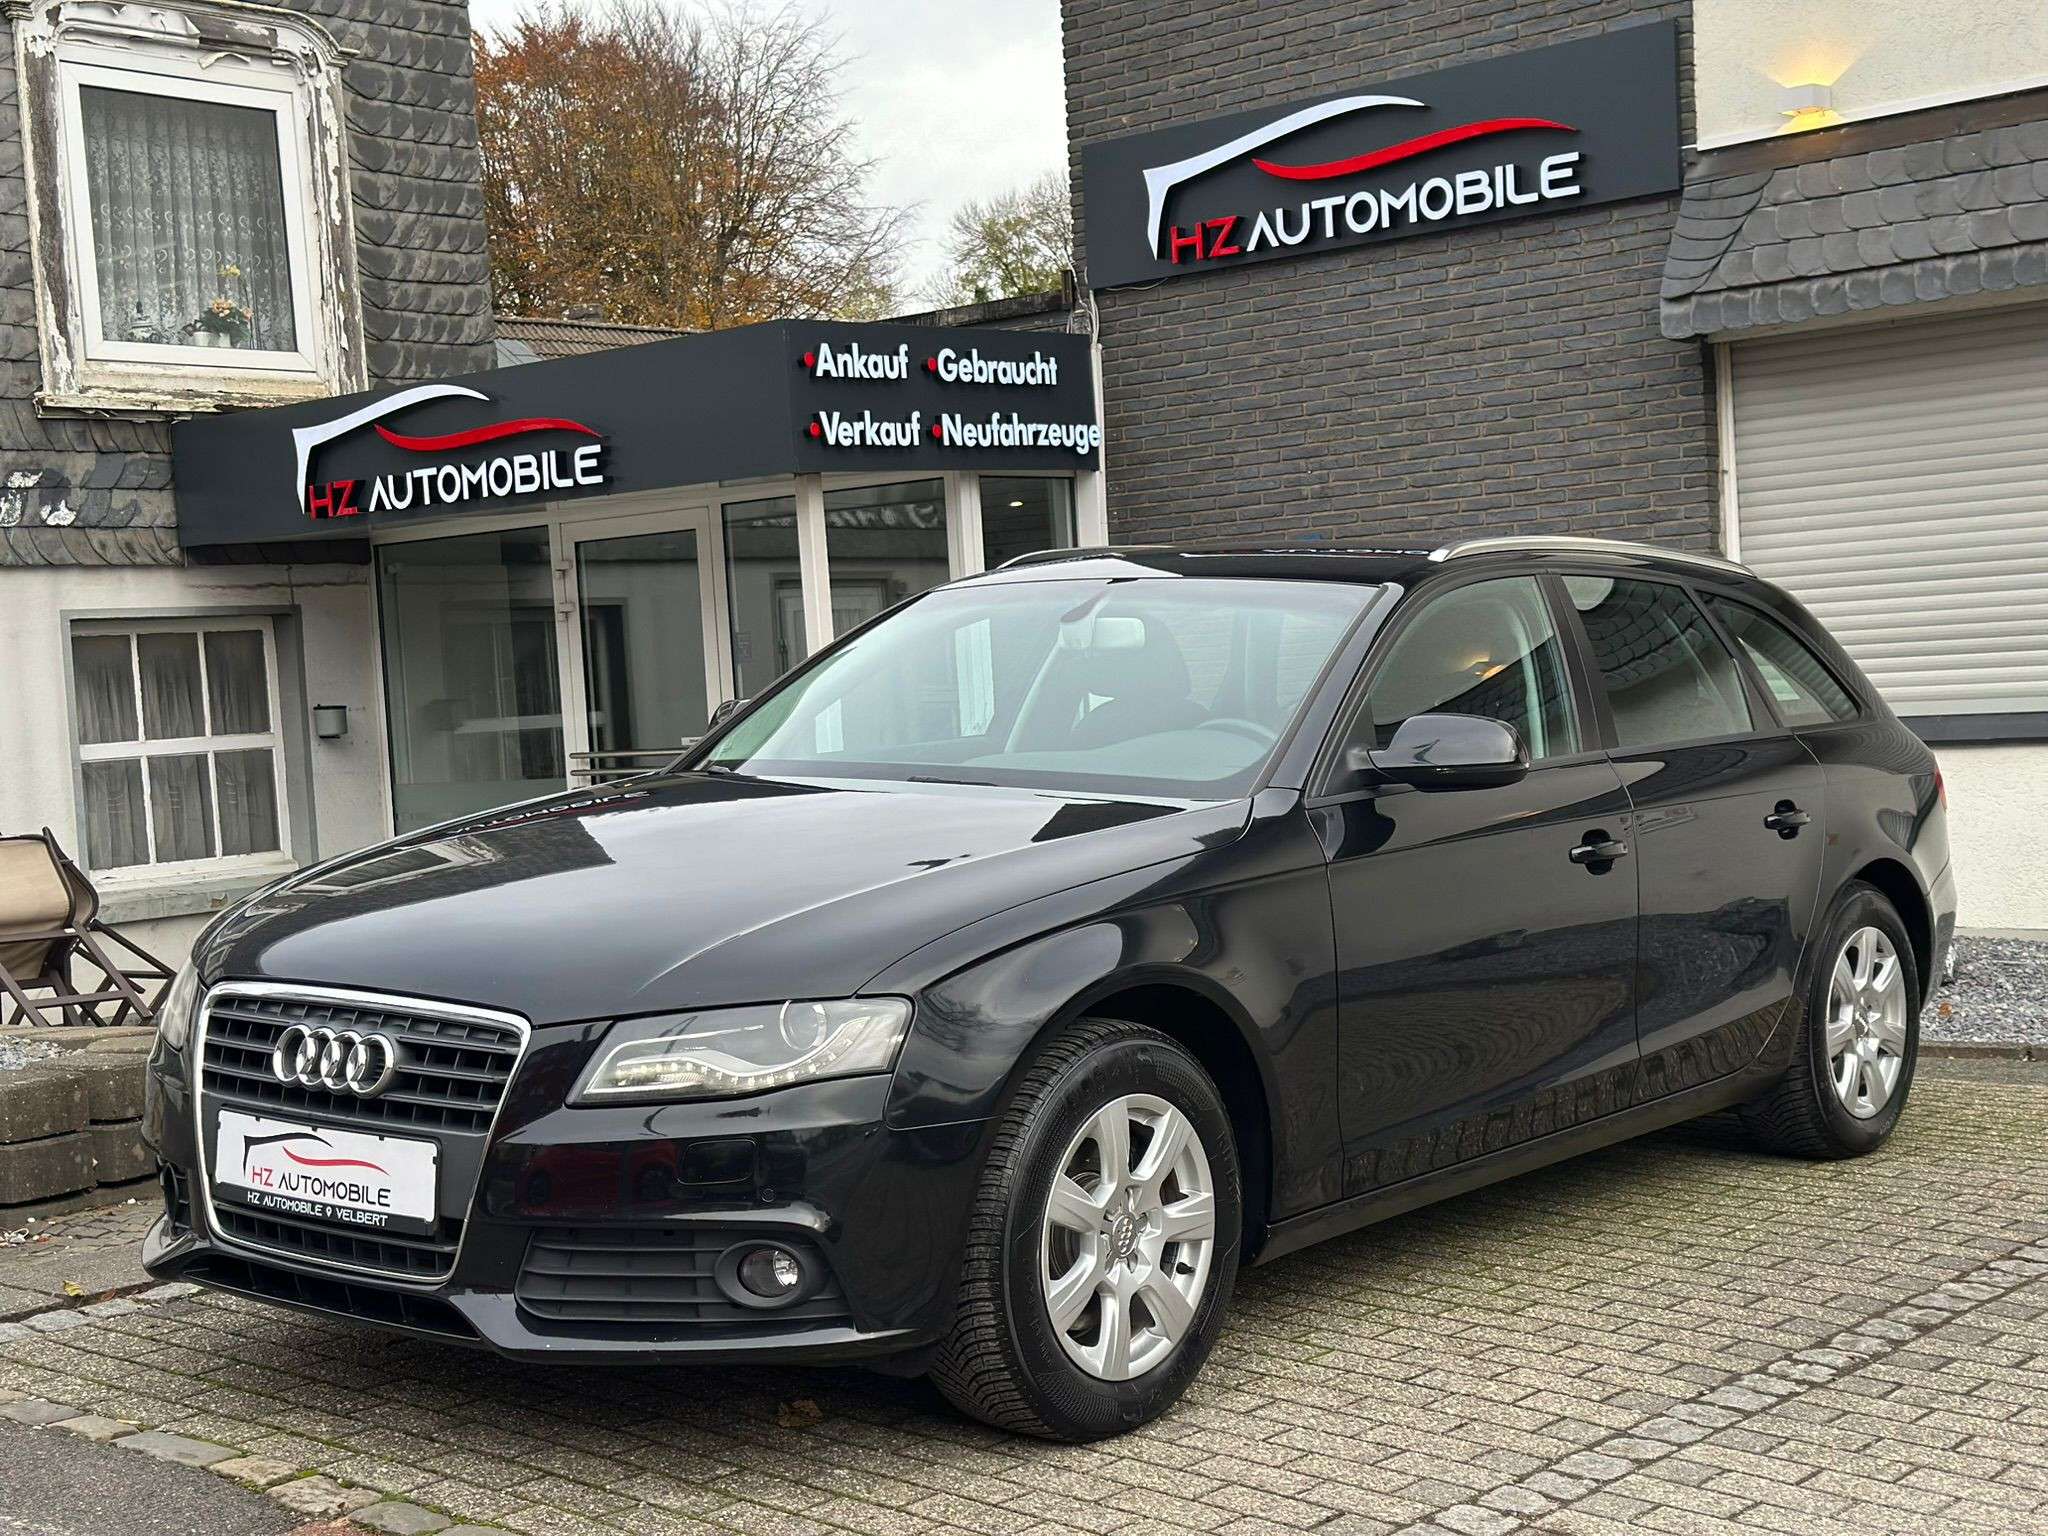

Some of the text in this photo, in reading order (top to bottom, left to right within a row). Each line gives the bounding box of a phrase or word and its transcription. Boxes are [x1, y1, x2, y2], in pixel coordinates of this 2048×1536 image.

[1171, 151, 1581, 265] HZ AUTOMOBILE
[815, 342, 1058, 385] Ankauf Gebraucht
[819, 411, 1101, 454] Verkauf Neufahrzeuge
[308, 444, 603, 519] HZ AUTOMOBILE
[252, 1165, 391, 1208] HZ AUTOMOBILE
[247, 1191, 388, 1227] HZ AUTOMOBILE VELBERT
